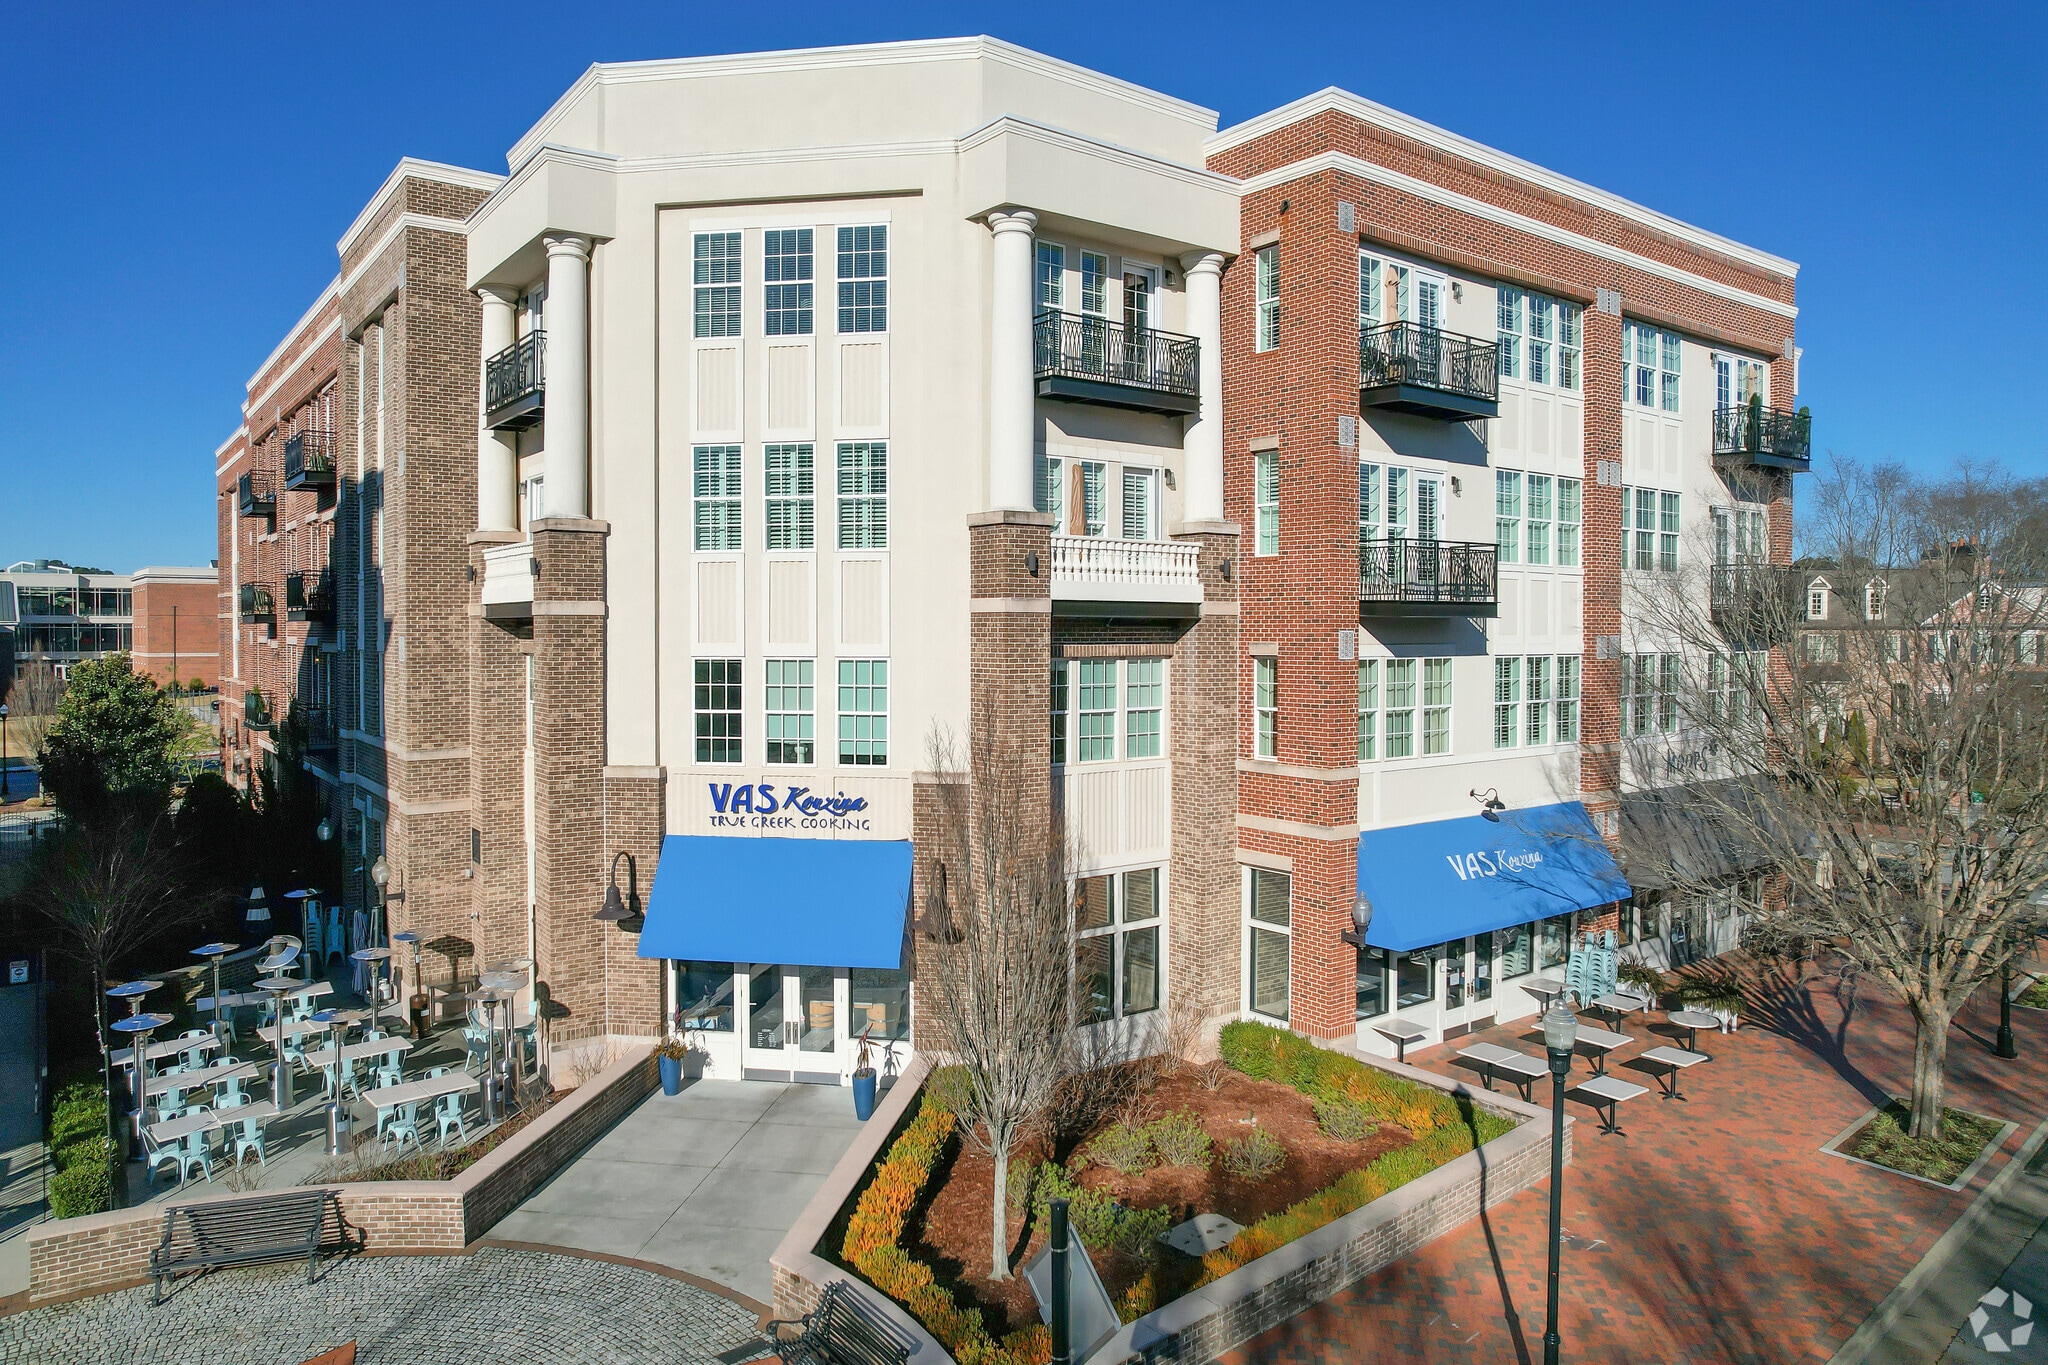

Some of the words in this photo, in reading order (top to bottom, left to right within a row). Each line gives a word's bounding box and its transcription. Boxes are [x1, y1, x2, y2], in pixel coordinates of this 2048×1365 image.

[708, 783, 779, 815] VAS
[709, 815, 746, 828] TRUE
[751, 816, 796, 829] GREEK
[801, 817, 871, 831] COOKING
[1446, 851, 1497, 880] VAS
